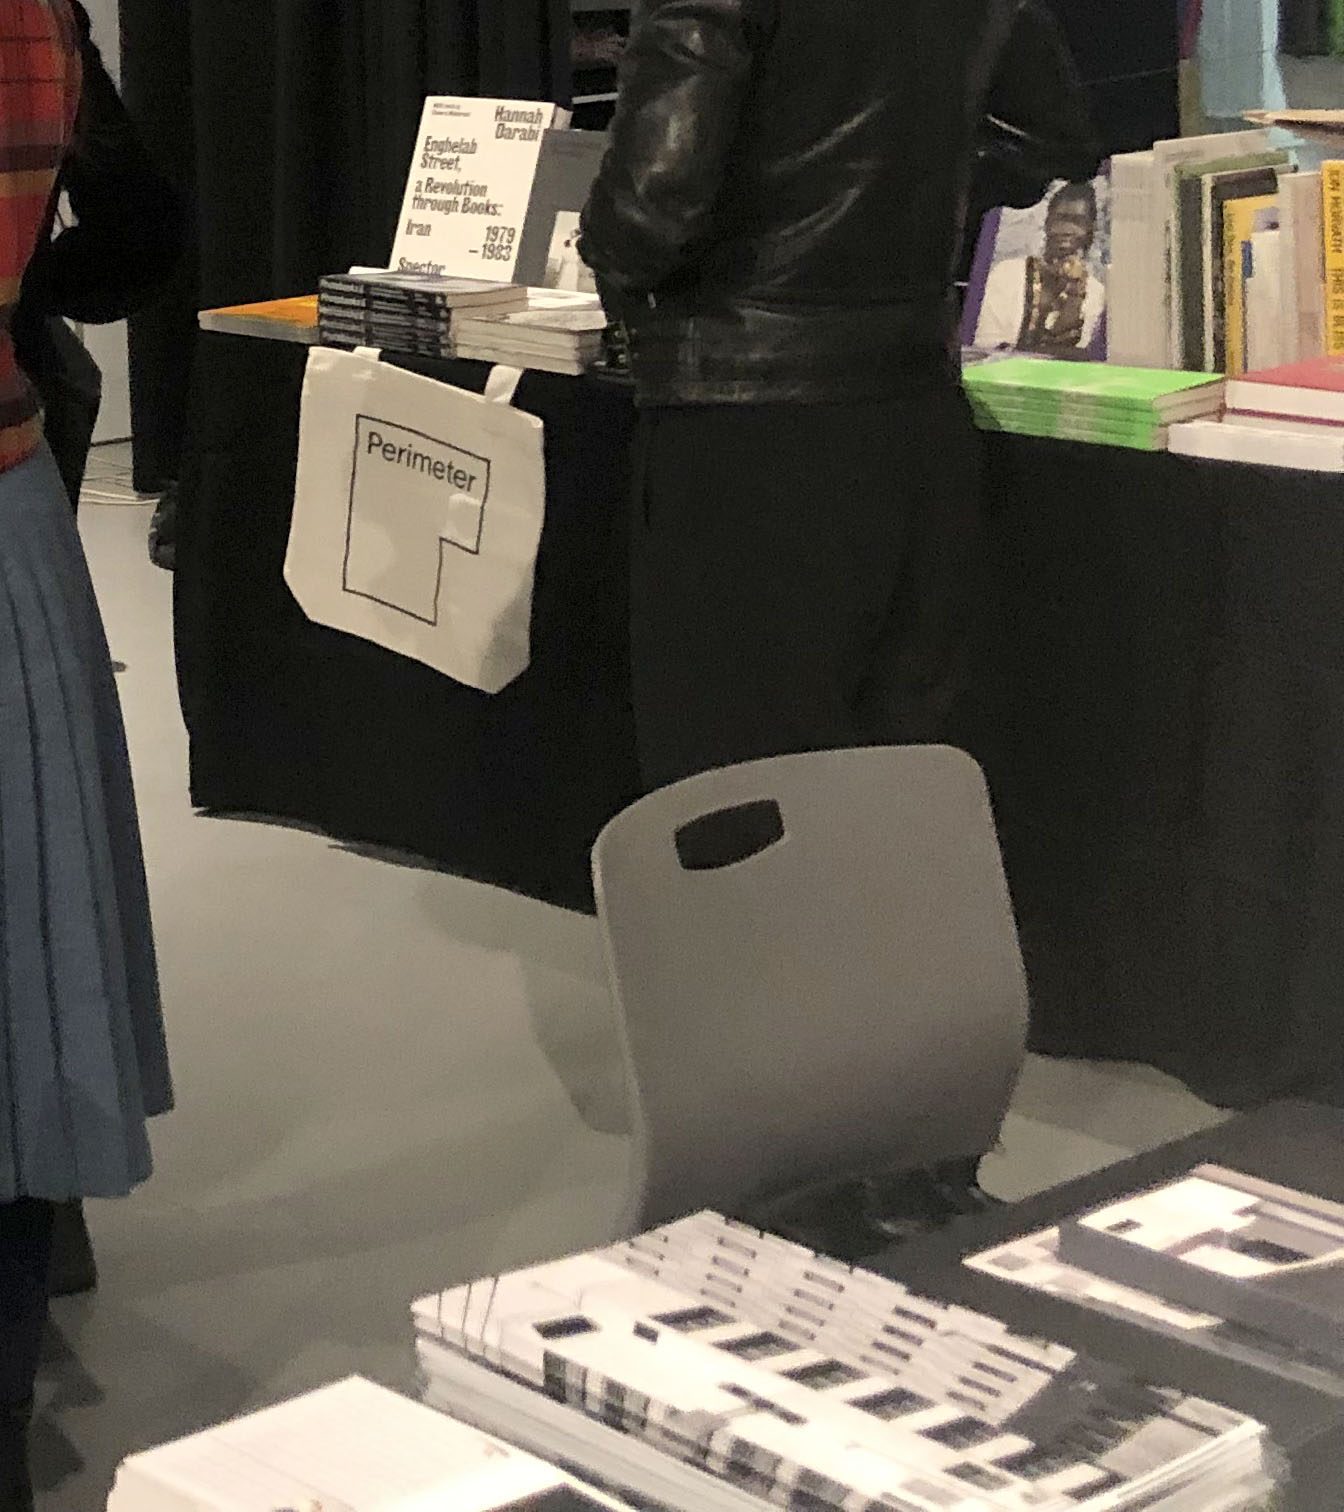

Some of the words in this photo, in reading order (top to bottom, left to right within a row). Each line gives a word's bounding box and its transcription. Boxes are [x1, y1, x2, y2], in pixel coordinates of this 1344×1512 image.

[494, 105, 544, 125] Hannah
[495, 123, 540, 142] Darabi
[423, 135, 478, 155] Enghelab
[420, 153, 462, 173] Street,
[414, 180, 423, 193] a
[424, 177, 488, 198] Revolution
[412, 194, 459, 216] through
[405, 219, 432, 237] Iran
[485, 225, 516, 244] 1979
[367, 431, 477, 492] Perimeter
